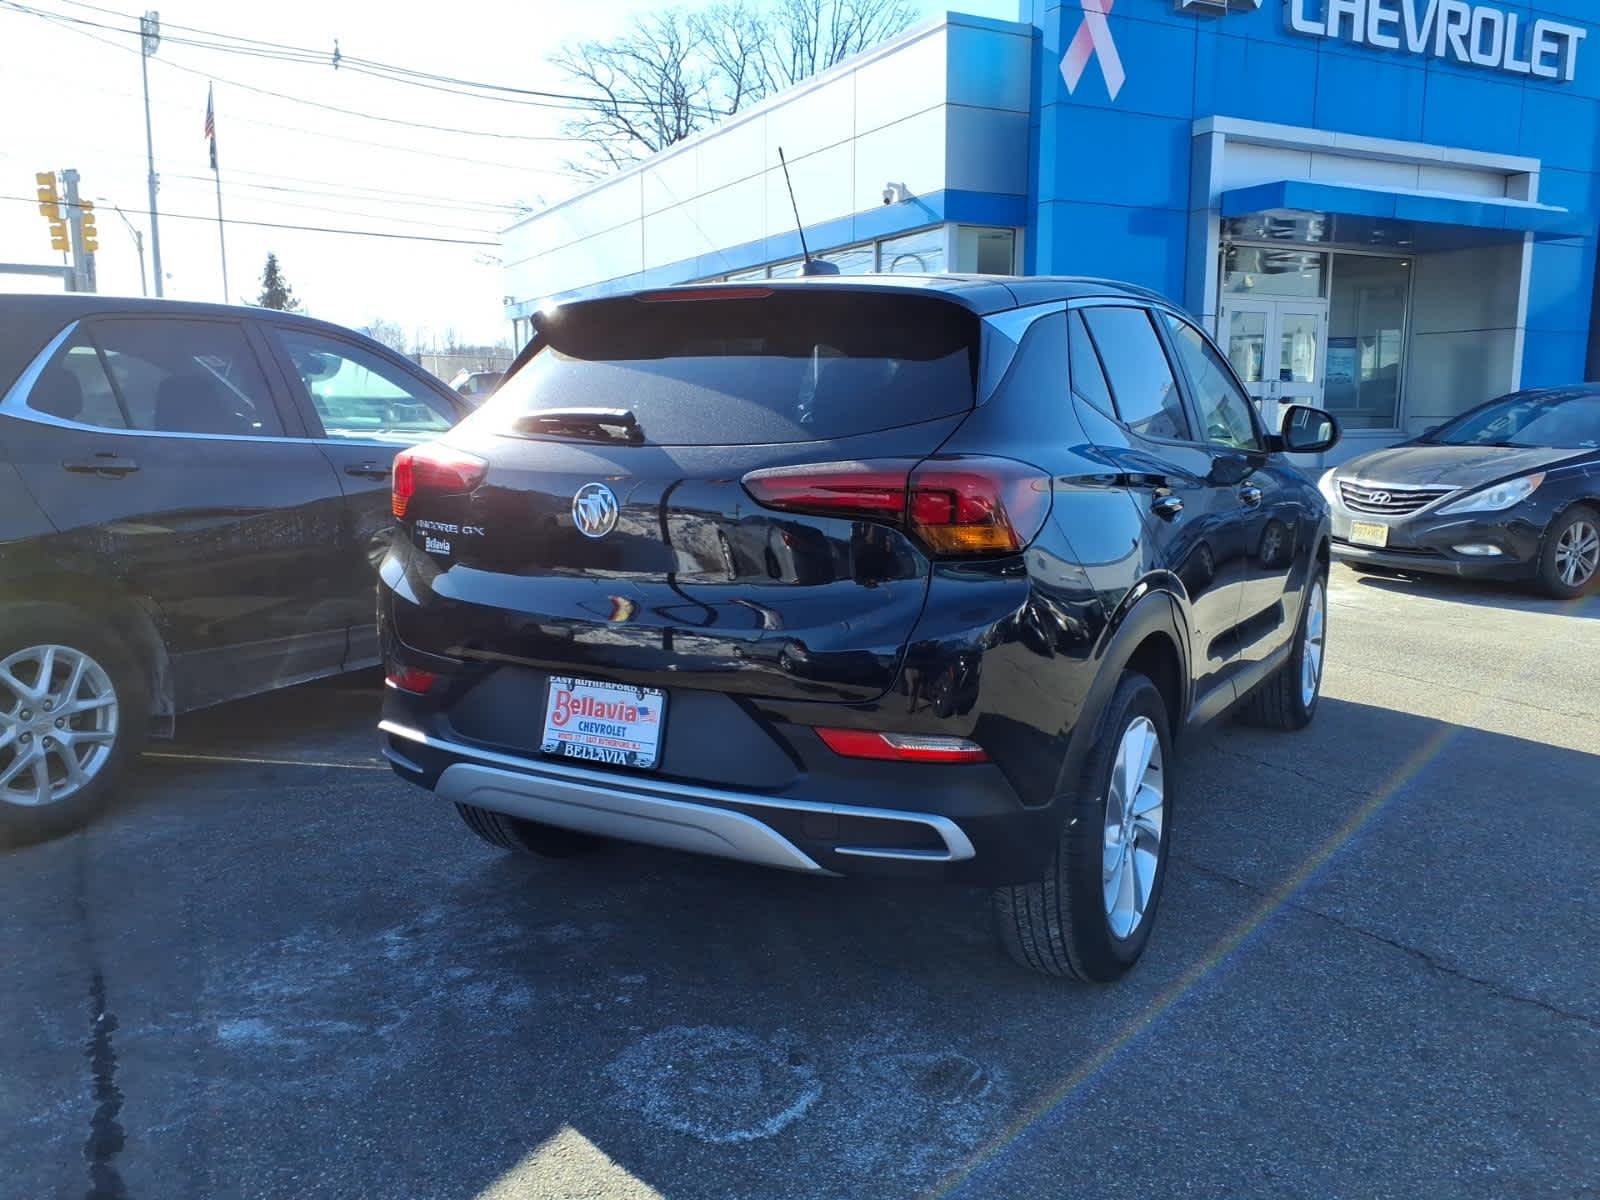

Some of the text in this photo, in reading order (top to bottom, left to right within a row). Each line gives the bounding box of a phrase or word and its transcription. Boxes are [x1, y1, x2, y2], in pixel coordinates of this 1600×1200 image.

[1290, 0, 1587, 81] CHEVROLET
[462, 526, 485, 536] GX
[550, 676, 573, 687] EAST
[552, 690, 638, 727] Bellavia
[578, 720, 626, 738] CHEVROLET
[564, 743, 627, 765] BELLAVIA
